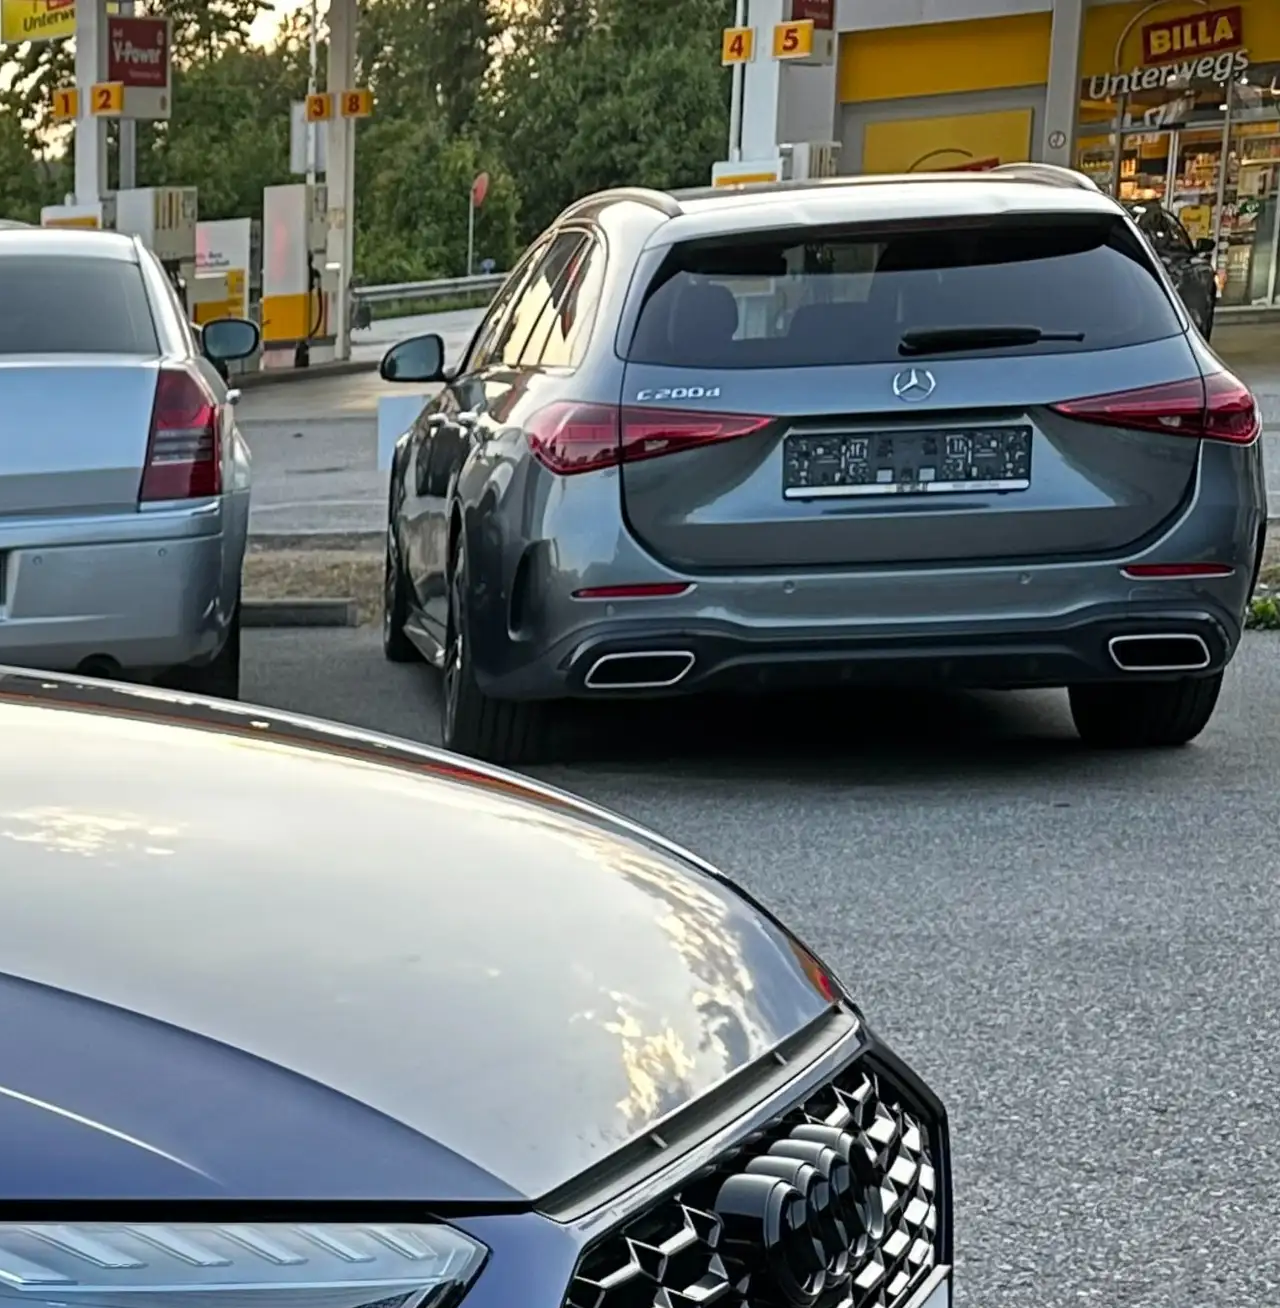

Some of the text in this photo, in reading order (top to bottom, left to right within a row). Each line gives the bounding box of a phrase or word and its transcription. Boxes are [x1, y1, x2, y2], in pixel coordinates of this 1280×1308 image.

[23, 8, 75, 32] Unterw
[729, 33, 744, 57] 4
[782, 27, 799, 51] 5
[1149, 15, 1234, 56] BILLA
[112, 39, 162, 64] V-Power
[1089, 48, 1249, 100] Unterwegs
[59, 93, 70, 114] 1
[97, 89, 112, 110] 2
[312, 96, 325, 117] 3
[348, 93, 360, 114] 8
